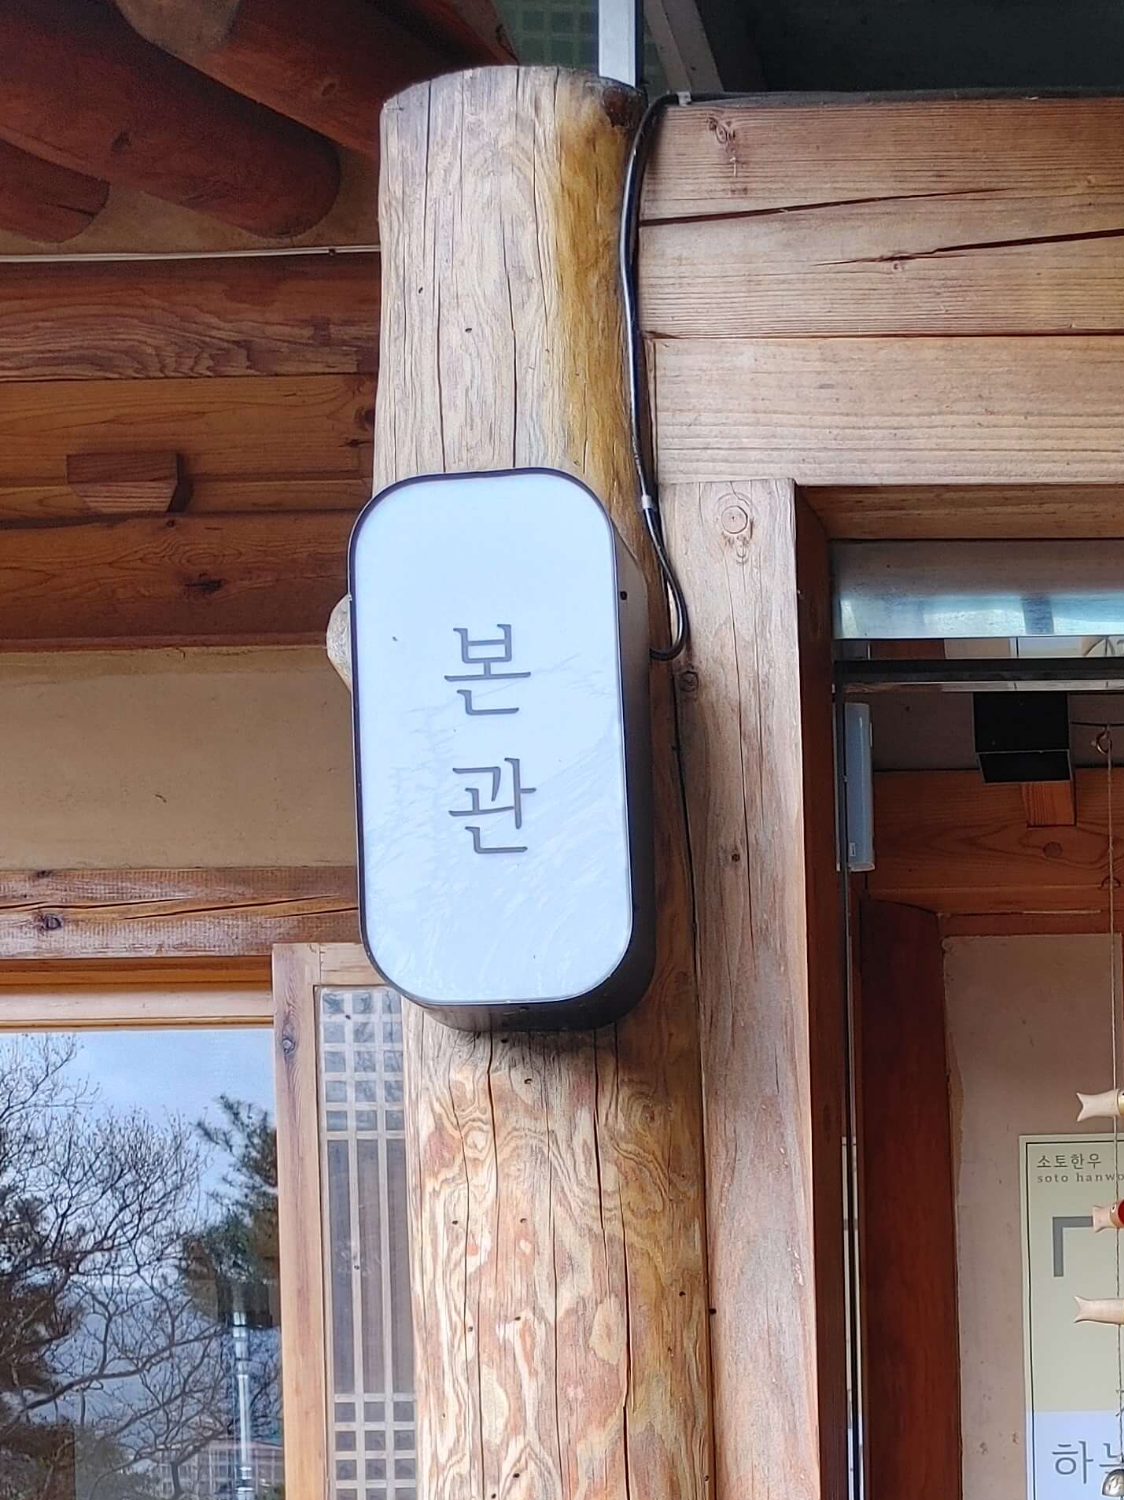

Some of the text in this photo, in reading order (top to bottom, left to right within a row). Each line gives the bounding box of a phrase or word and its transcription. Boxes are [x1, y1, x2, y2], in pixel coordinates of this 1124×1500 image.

[444, 623, 537, 855] 본관
[1036, 1152, 1102, 1170] 소토한우
[1037, 1173, 1069, 1183] soto
